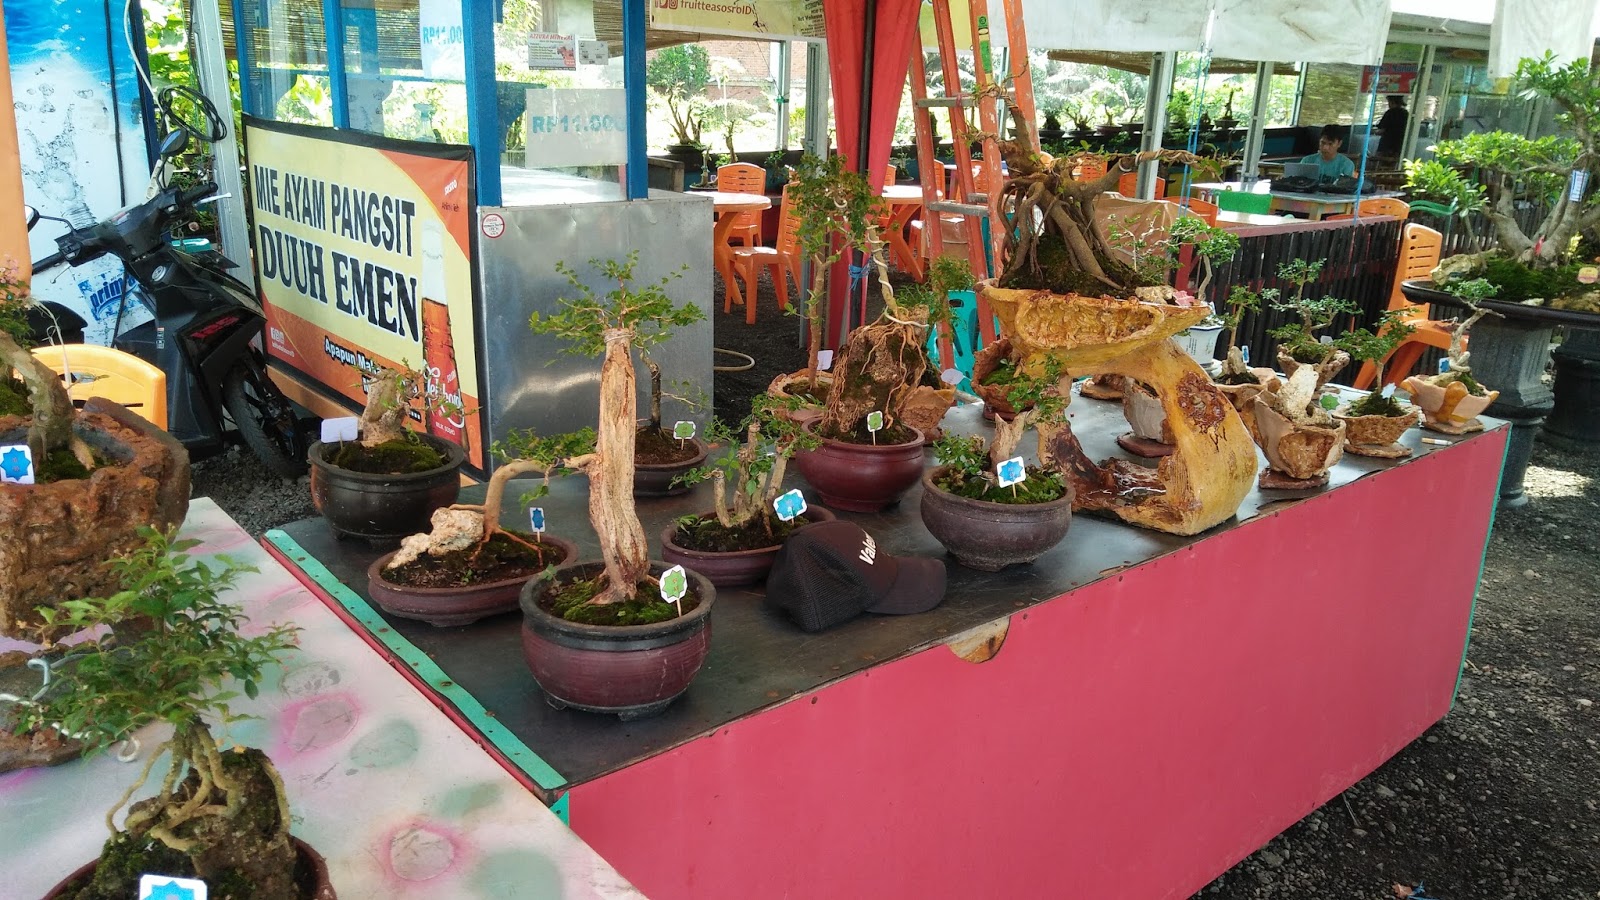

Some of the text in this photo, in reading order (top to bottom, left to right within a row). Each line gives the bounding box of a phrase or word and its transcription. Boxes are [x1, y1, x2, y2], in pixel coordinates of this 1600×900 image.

[254, 164, 415, 257] MIE AYAM PANGSIT
[259, 224, 419, 343] DUUH EMEN
[325, 336, 356, 365] Apapun
